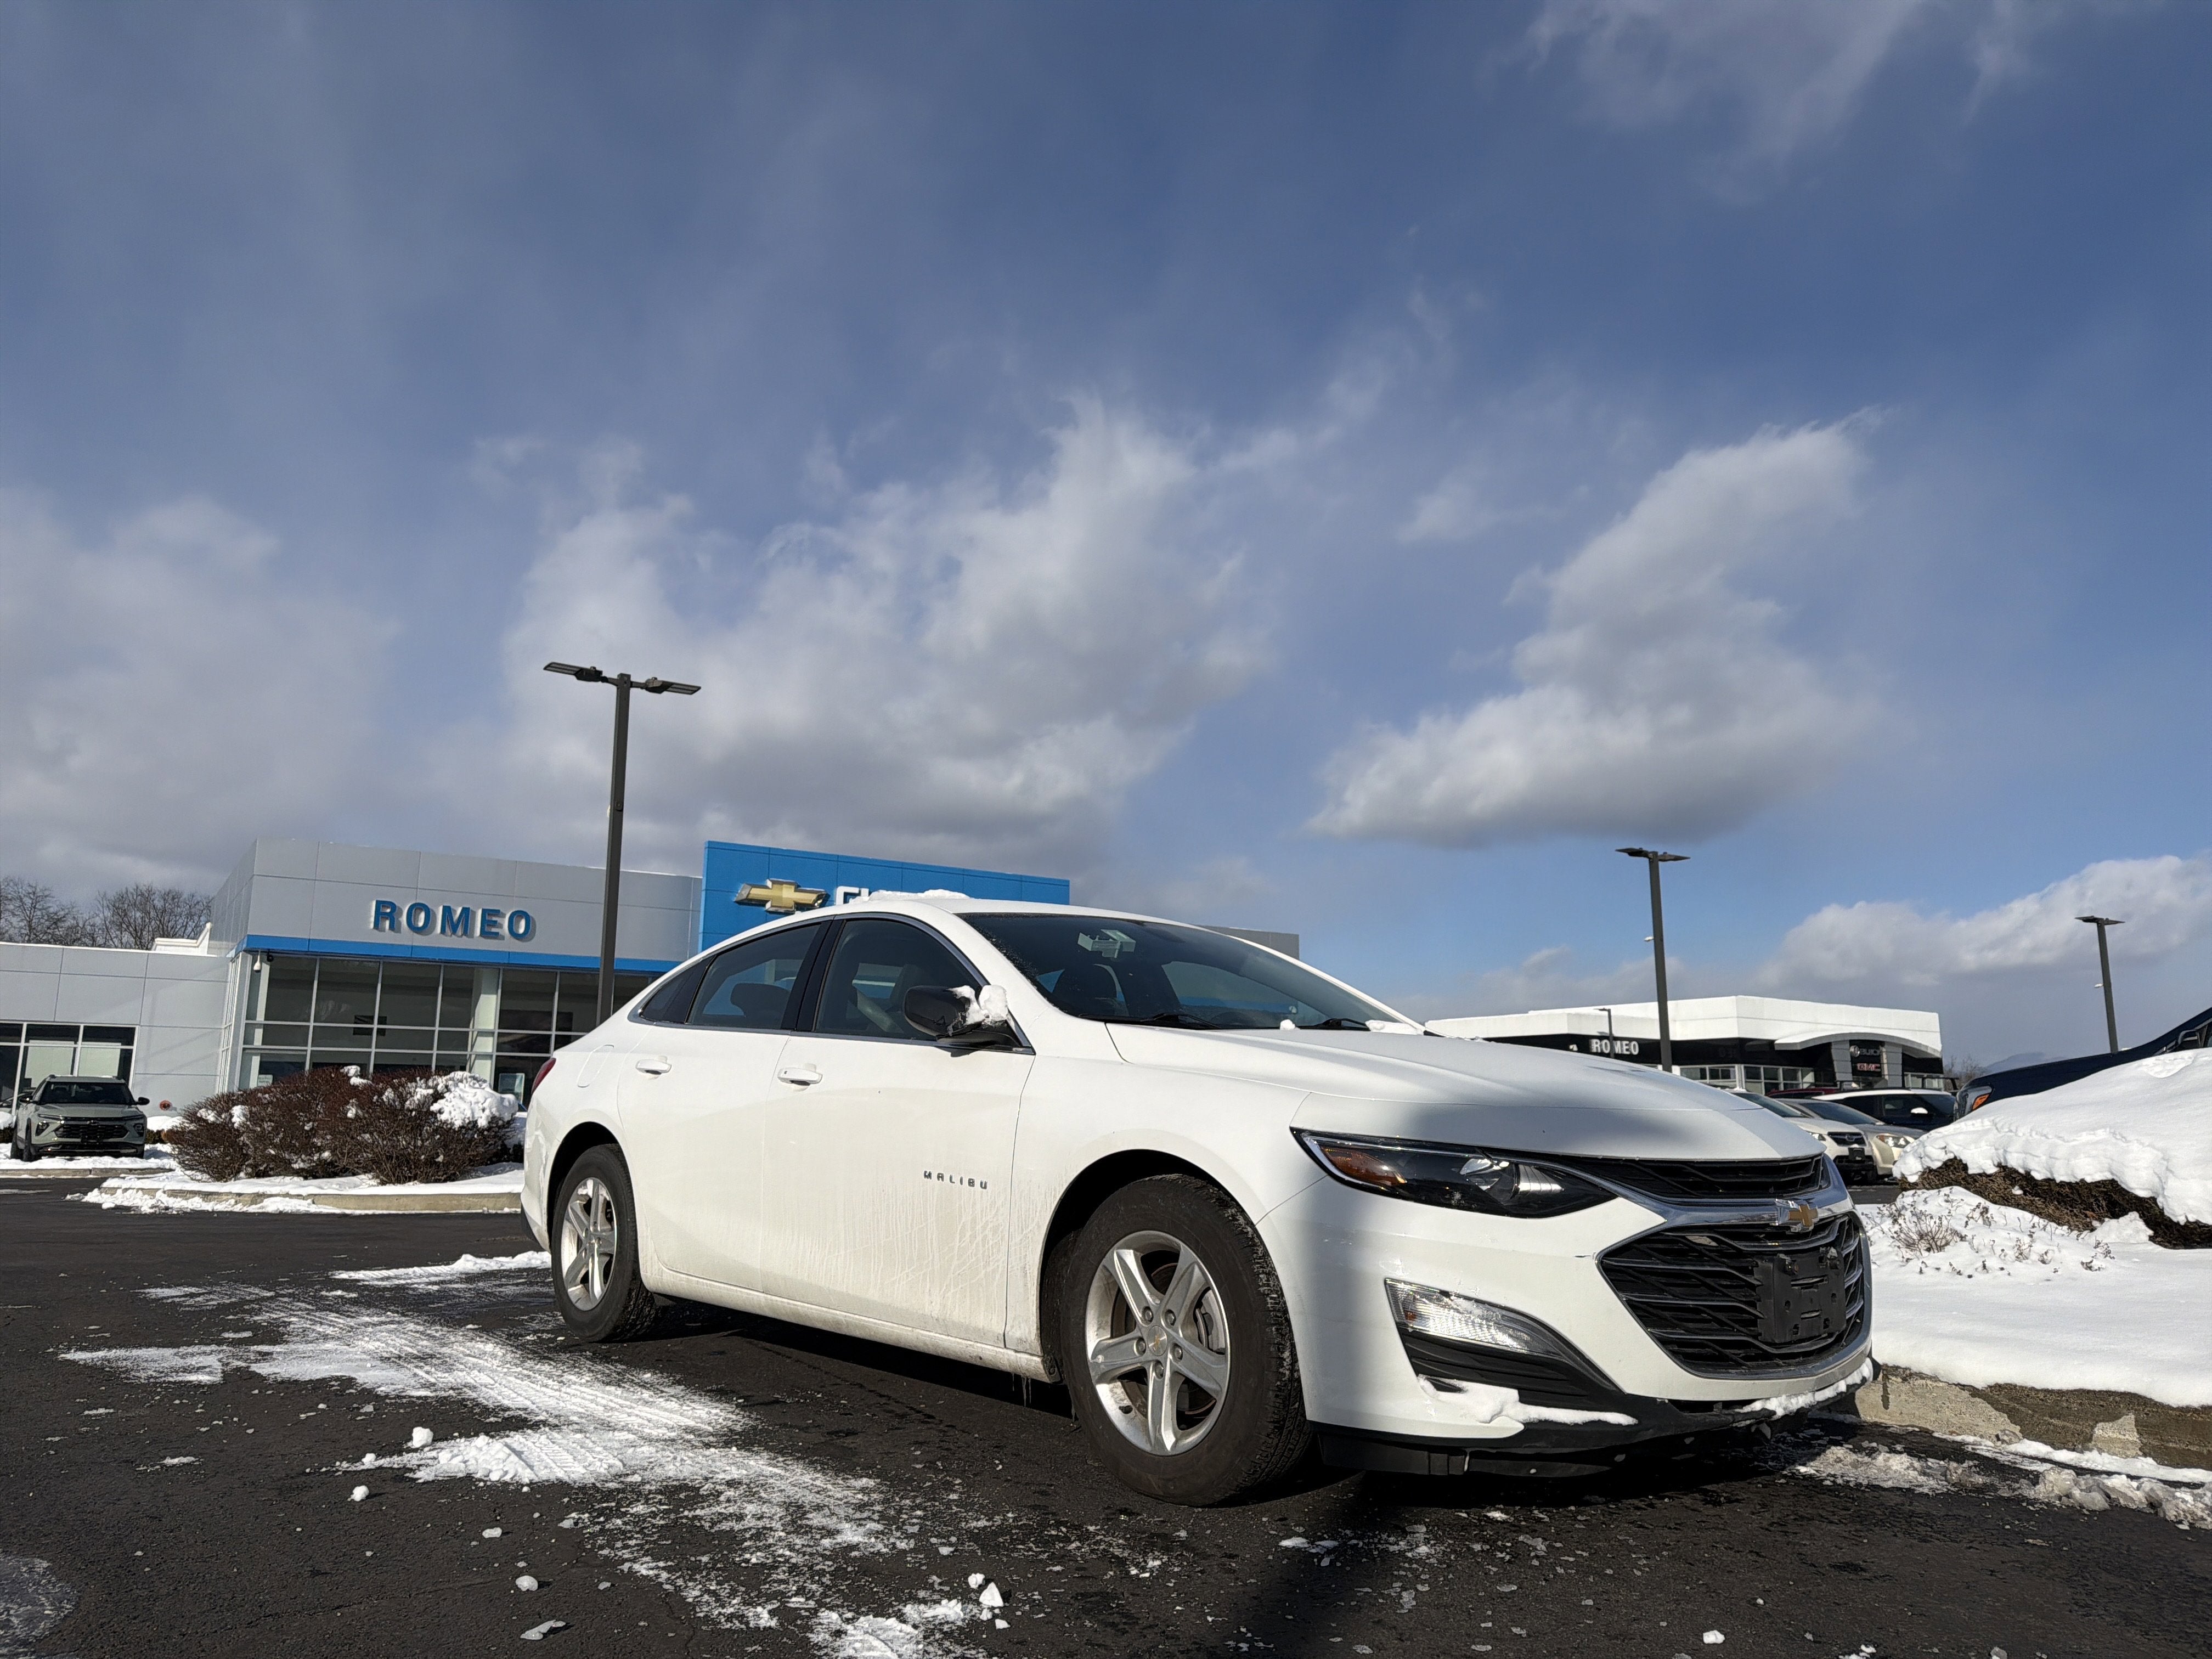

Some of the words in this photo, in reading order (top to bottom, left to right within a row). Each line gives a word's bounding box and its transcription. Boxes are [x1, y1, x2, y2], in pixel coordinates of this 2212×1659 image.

[371, 900, 532, 940] ROMEO
[1590, 1039, 1639, 1055] ROMEO
[924, 1171, 988, 1189] MALIBU
